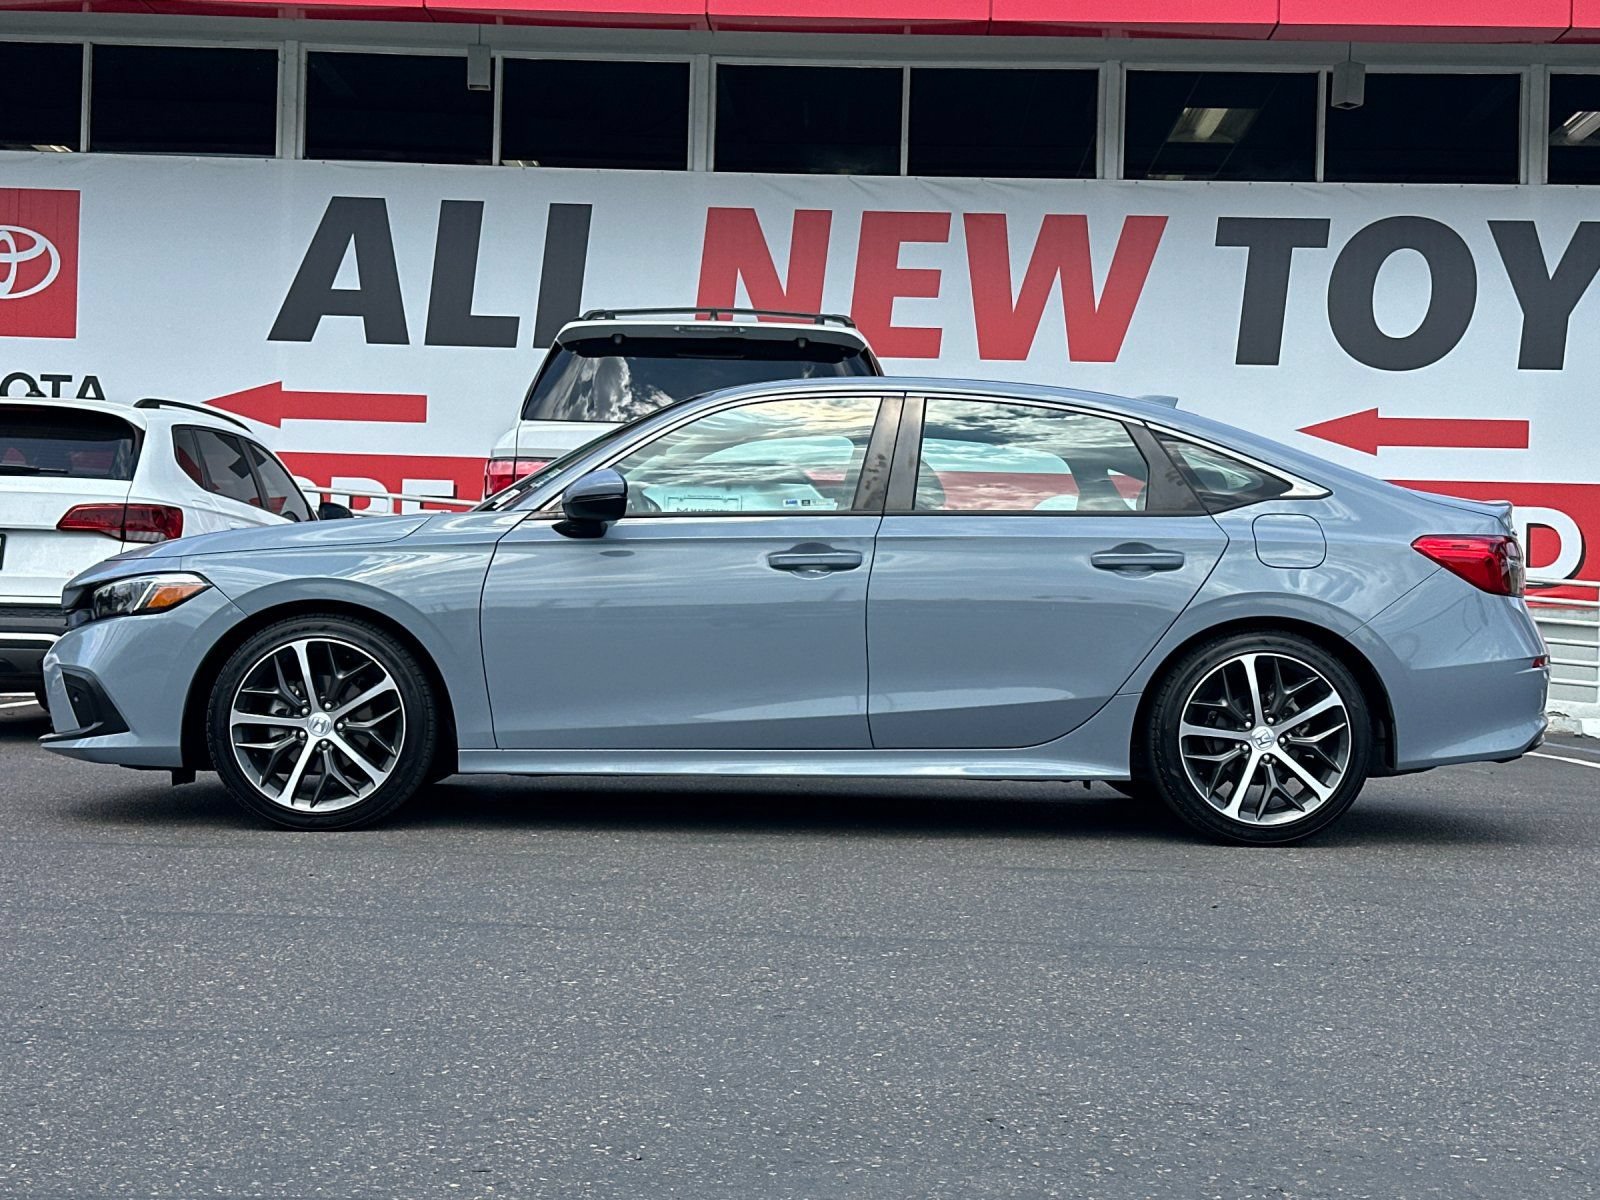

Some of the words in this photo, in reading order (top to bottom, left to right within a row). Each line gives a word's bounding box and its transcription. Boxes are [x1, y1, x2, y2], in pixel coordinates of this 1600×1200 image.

[267, 196, 593, 349] ALL
[695, 206, 1169, 362] NEW
[1215, 215, 1600, 371] TOY
